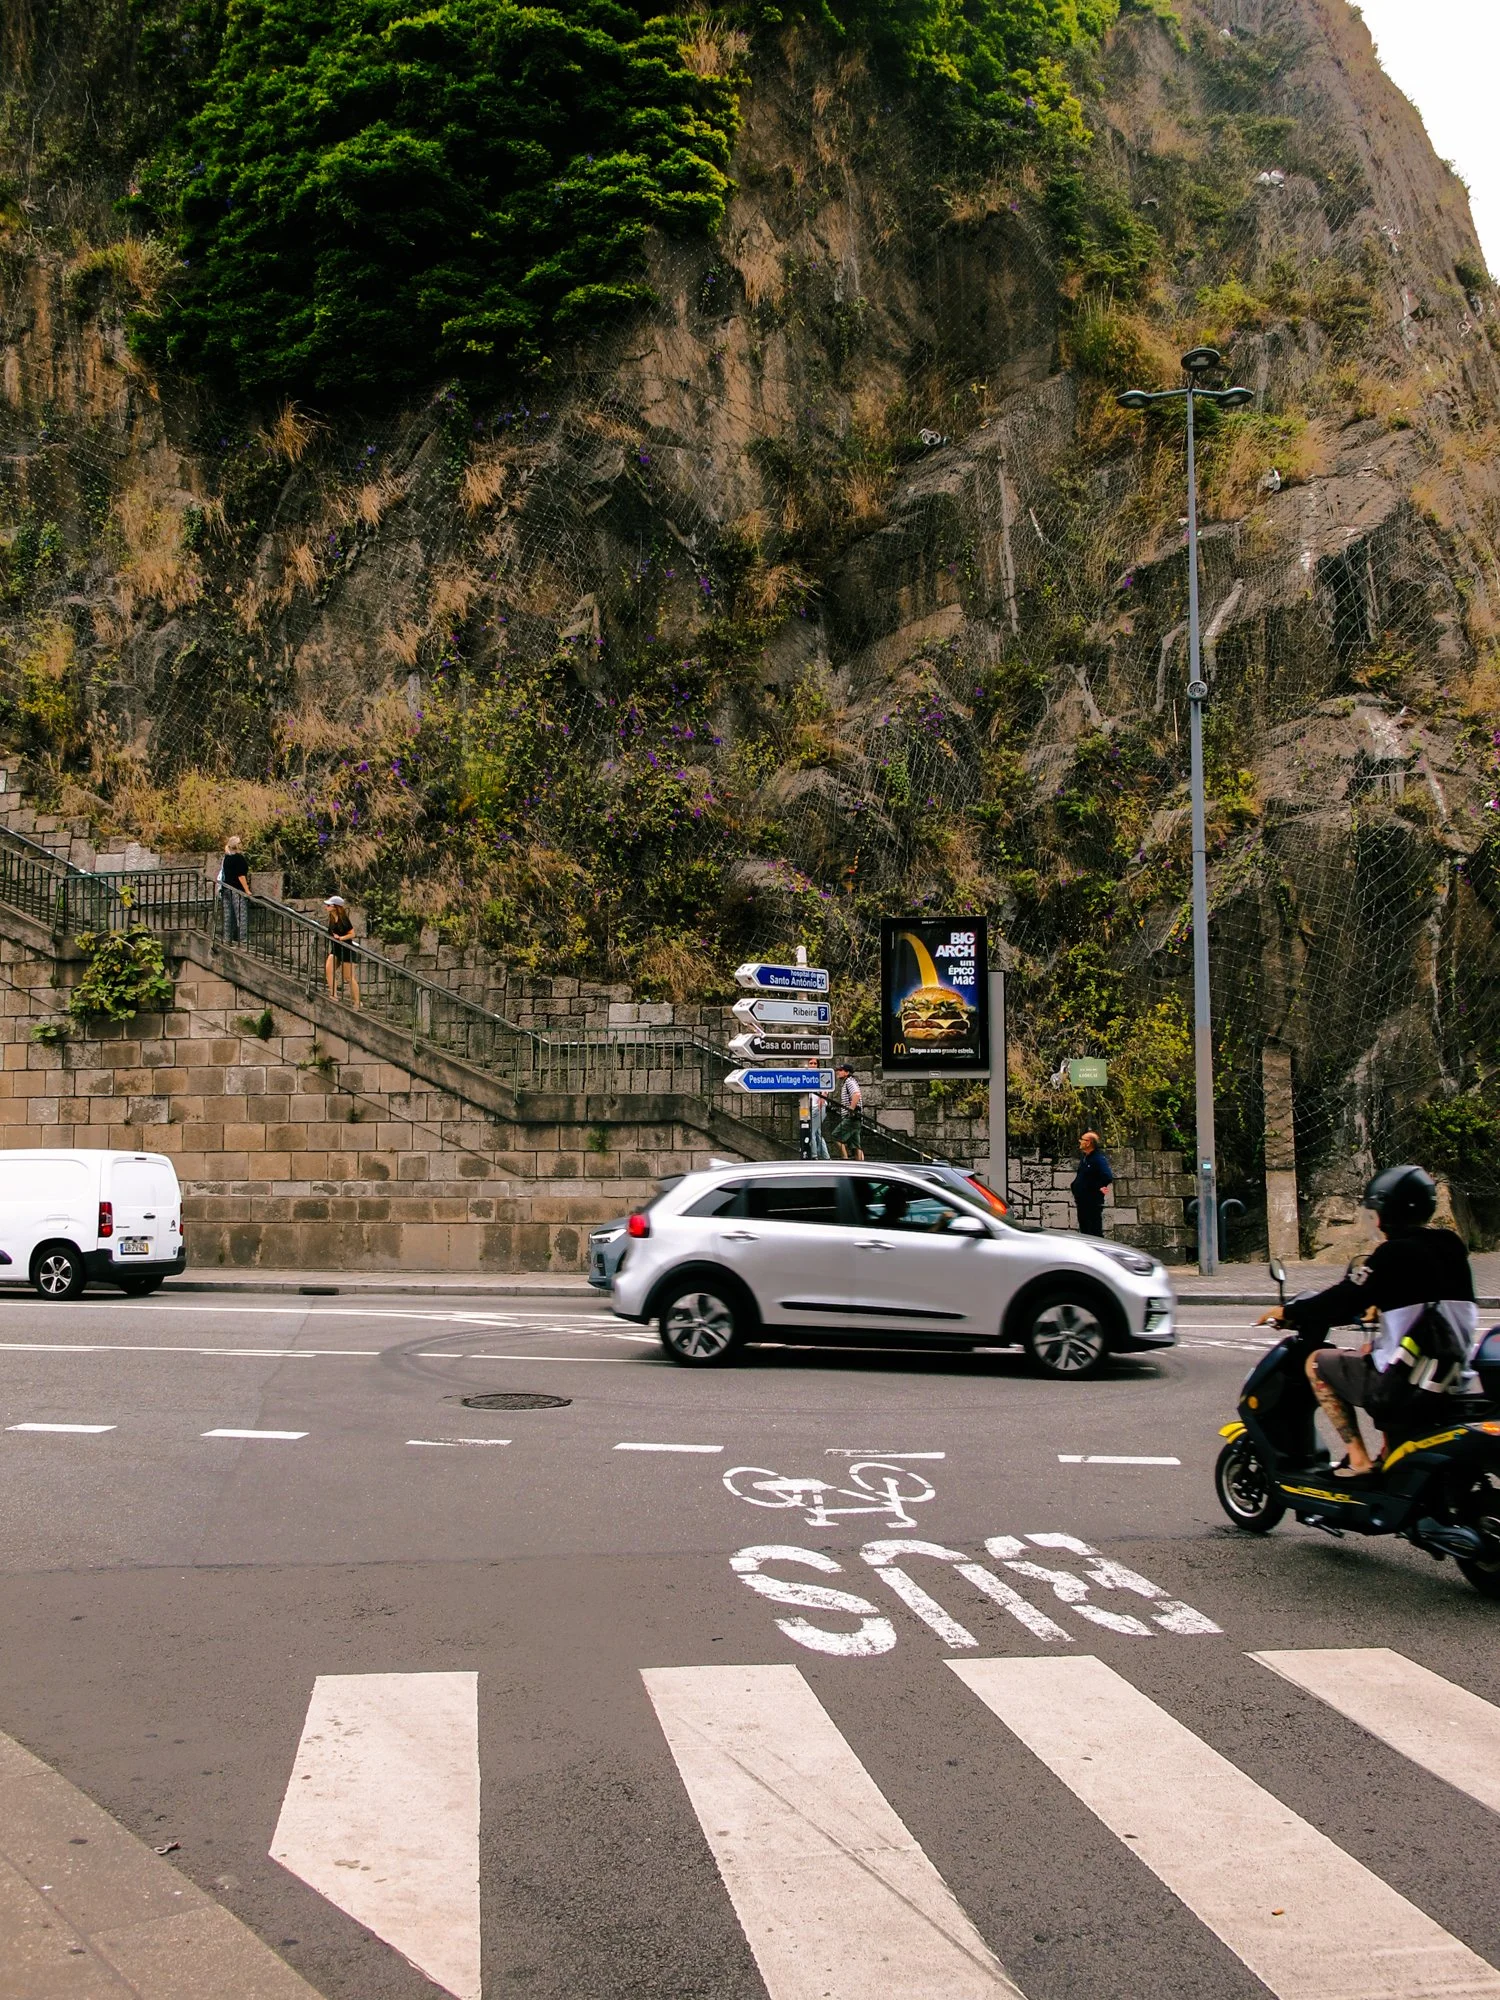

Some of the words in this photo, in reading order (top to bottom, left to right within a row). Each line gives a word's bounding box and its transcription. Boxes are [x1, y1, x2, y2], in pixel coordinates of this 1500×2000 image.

[951, 932, 975, 944] BIG
[935, 945, 975, 957] ARCH
[948, 965, 974, 975] ÉPICO
[770, 975, 790, 985] Santo
[791, 977, 817, 987] António
[793, 1007, 817, 1016] Ribeira
[760, 1040, 779, 1050] Casa
[781, 1041, 791, 1050] do
[793, 1041, 819, 1050] Infante
[749, 1075, 774, 1084] Pestana
[776, 1075, 800, 1086] Vintage
[802, 1075, 819, 1084] Porto
[729, 1532, 1223, 1656] BUS
